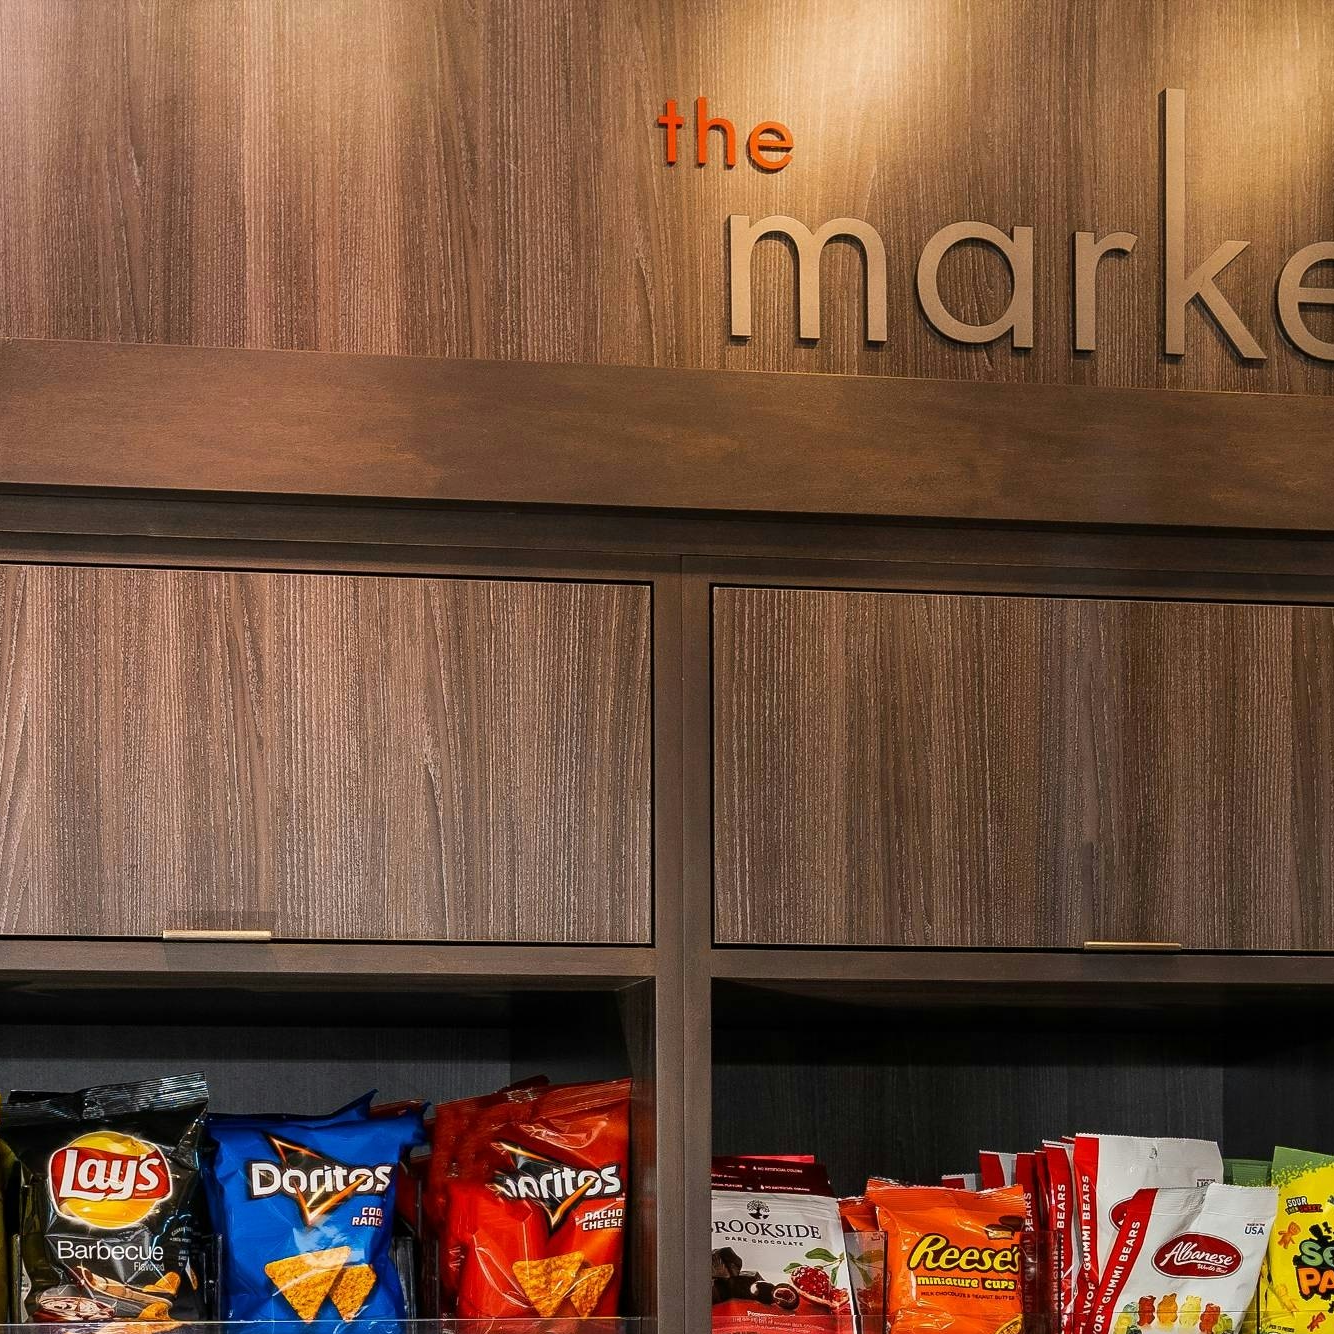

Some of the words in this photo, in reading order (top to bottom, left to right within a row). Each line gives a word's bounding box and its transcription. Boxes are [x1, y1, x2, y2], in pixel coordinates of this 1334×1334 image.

[658, 97, 795, 171] the
[58, 1149, 162, 1201] Lay's
[251, 1163, 392, 1198] Doritos
[1057, 1184, 1066, 1229] BEARS
[1082, 1175, 1091, 1221] BEARS
[1287, 1196, 1308, 1207] SOUR
[582, 1219, 623, 1231] CHEESE
[1245, 1226, 1265, 1235] USA
[57, 1240, 165, 1263] Barbecue
[909, 1234, 1020, 1272] Reese's
[1082, 1224, 1091, 1270] GUMMI
[1102, 1266, 1124, 1304] GUMMI
[1119, 1221, 1141, 1262] BEARS
[1159, 1241, 1235, 1267] Albanese
